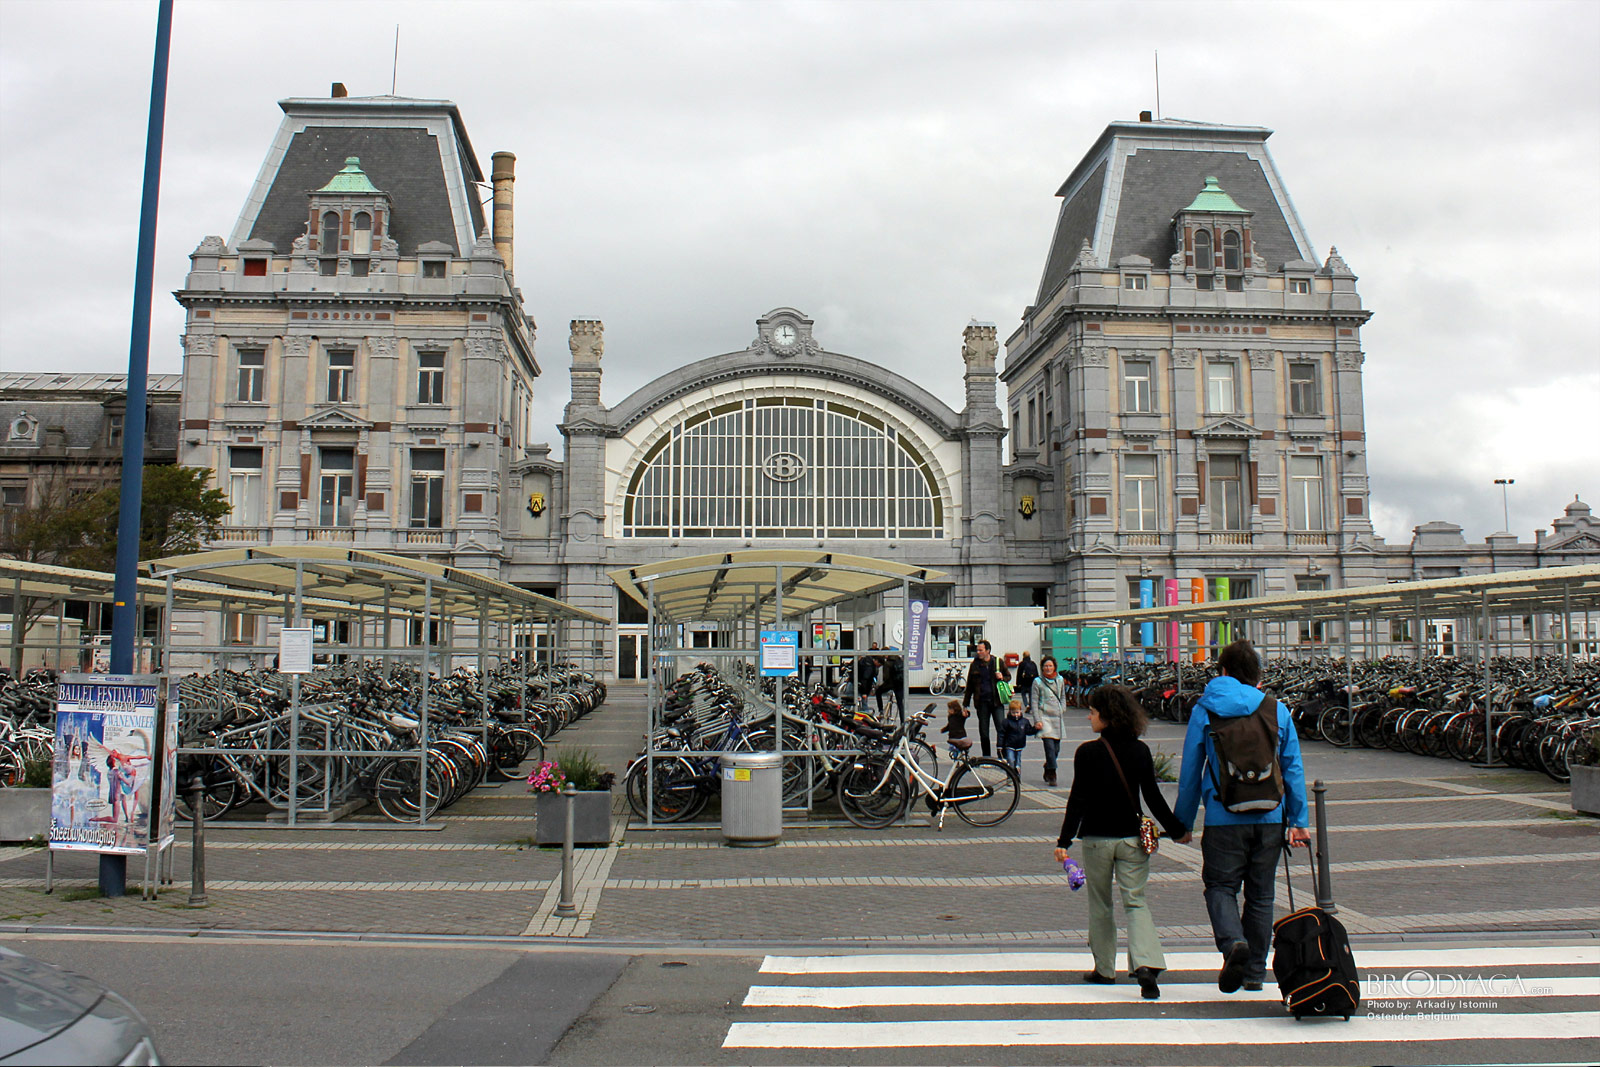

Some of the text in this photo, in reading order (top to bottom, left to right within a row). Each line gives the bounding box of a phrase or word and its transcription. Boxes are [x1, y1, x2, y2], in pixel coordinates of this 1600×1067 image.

[775, 457, 796, 477] B
[909, 614, 921, 658] Fietspunt
[59, 684, 94, 701] BALLET
[97, 686, 139, 704] FESTIVAL
